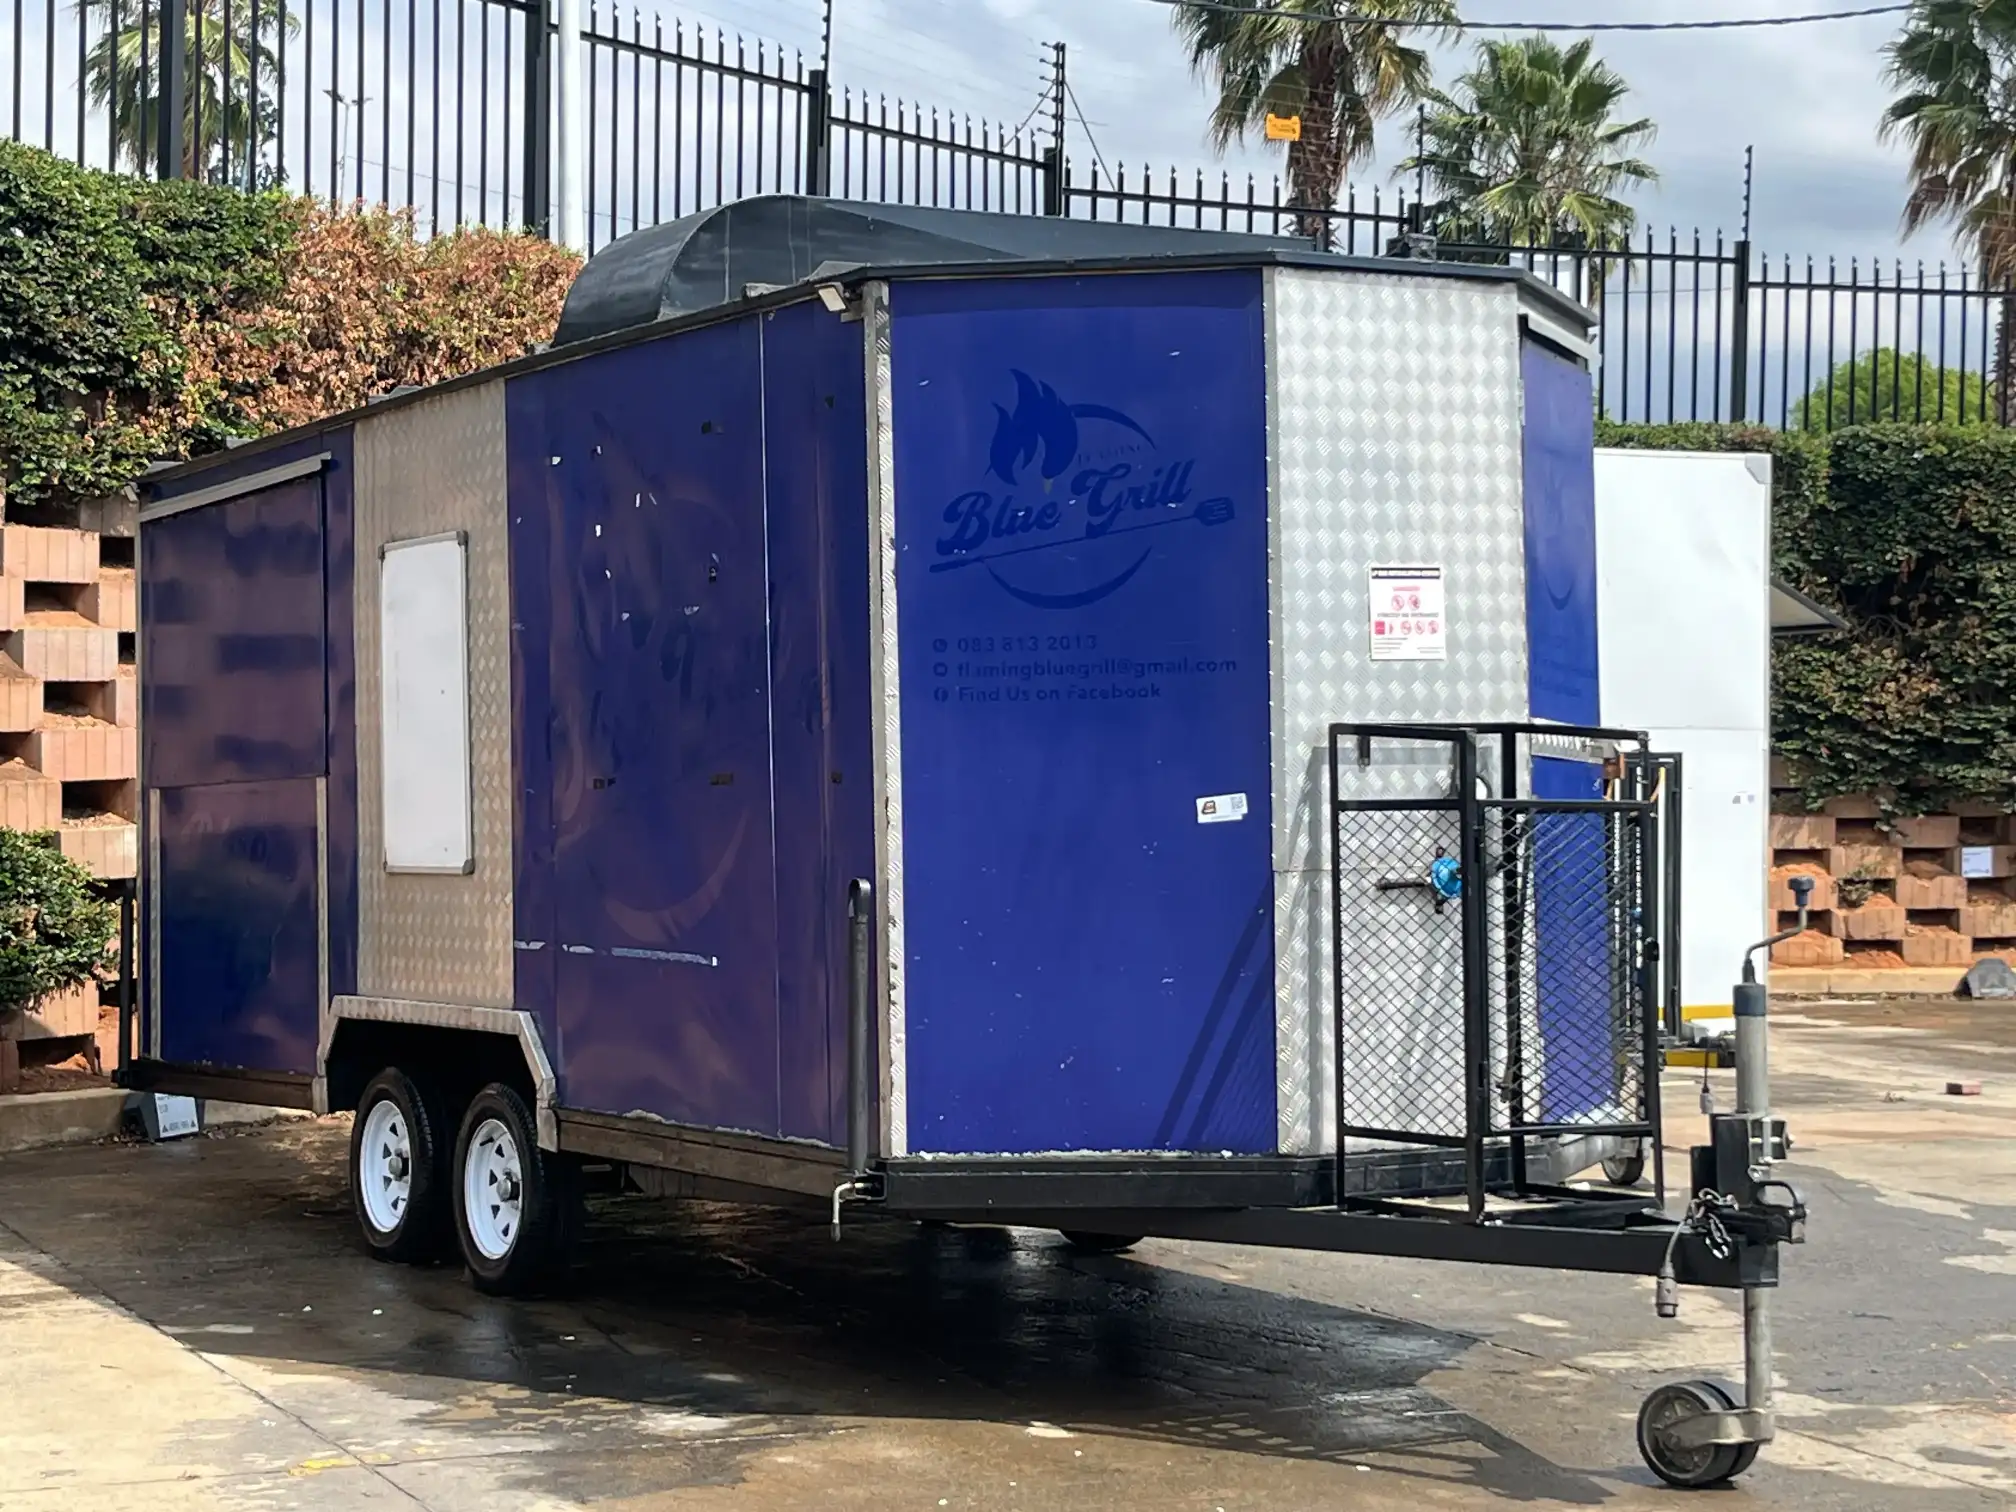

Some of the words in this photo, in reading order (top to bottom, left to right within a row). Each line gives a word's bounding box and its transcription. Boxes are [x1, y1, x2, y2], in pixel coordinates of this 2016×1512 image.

[936, 491, 1061, 556] Blue
[1070, 459, 1196, 539] Grill
[958, 686, 1000, 702] Find
[1006, 685, 1030, 702] Us
[1036, 689, 1060, 701] on
[1067, 682, 1162, 700] Facebook
